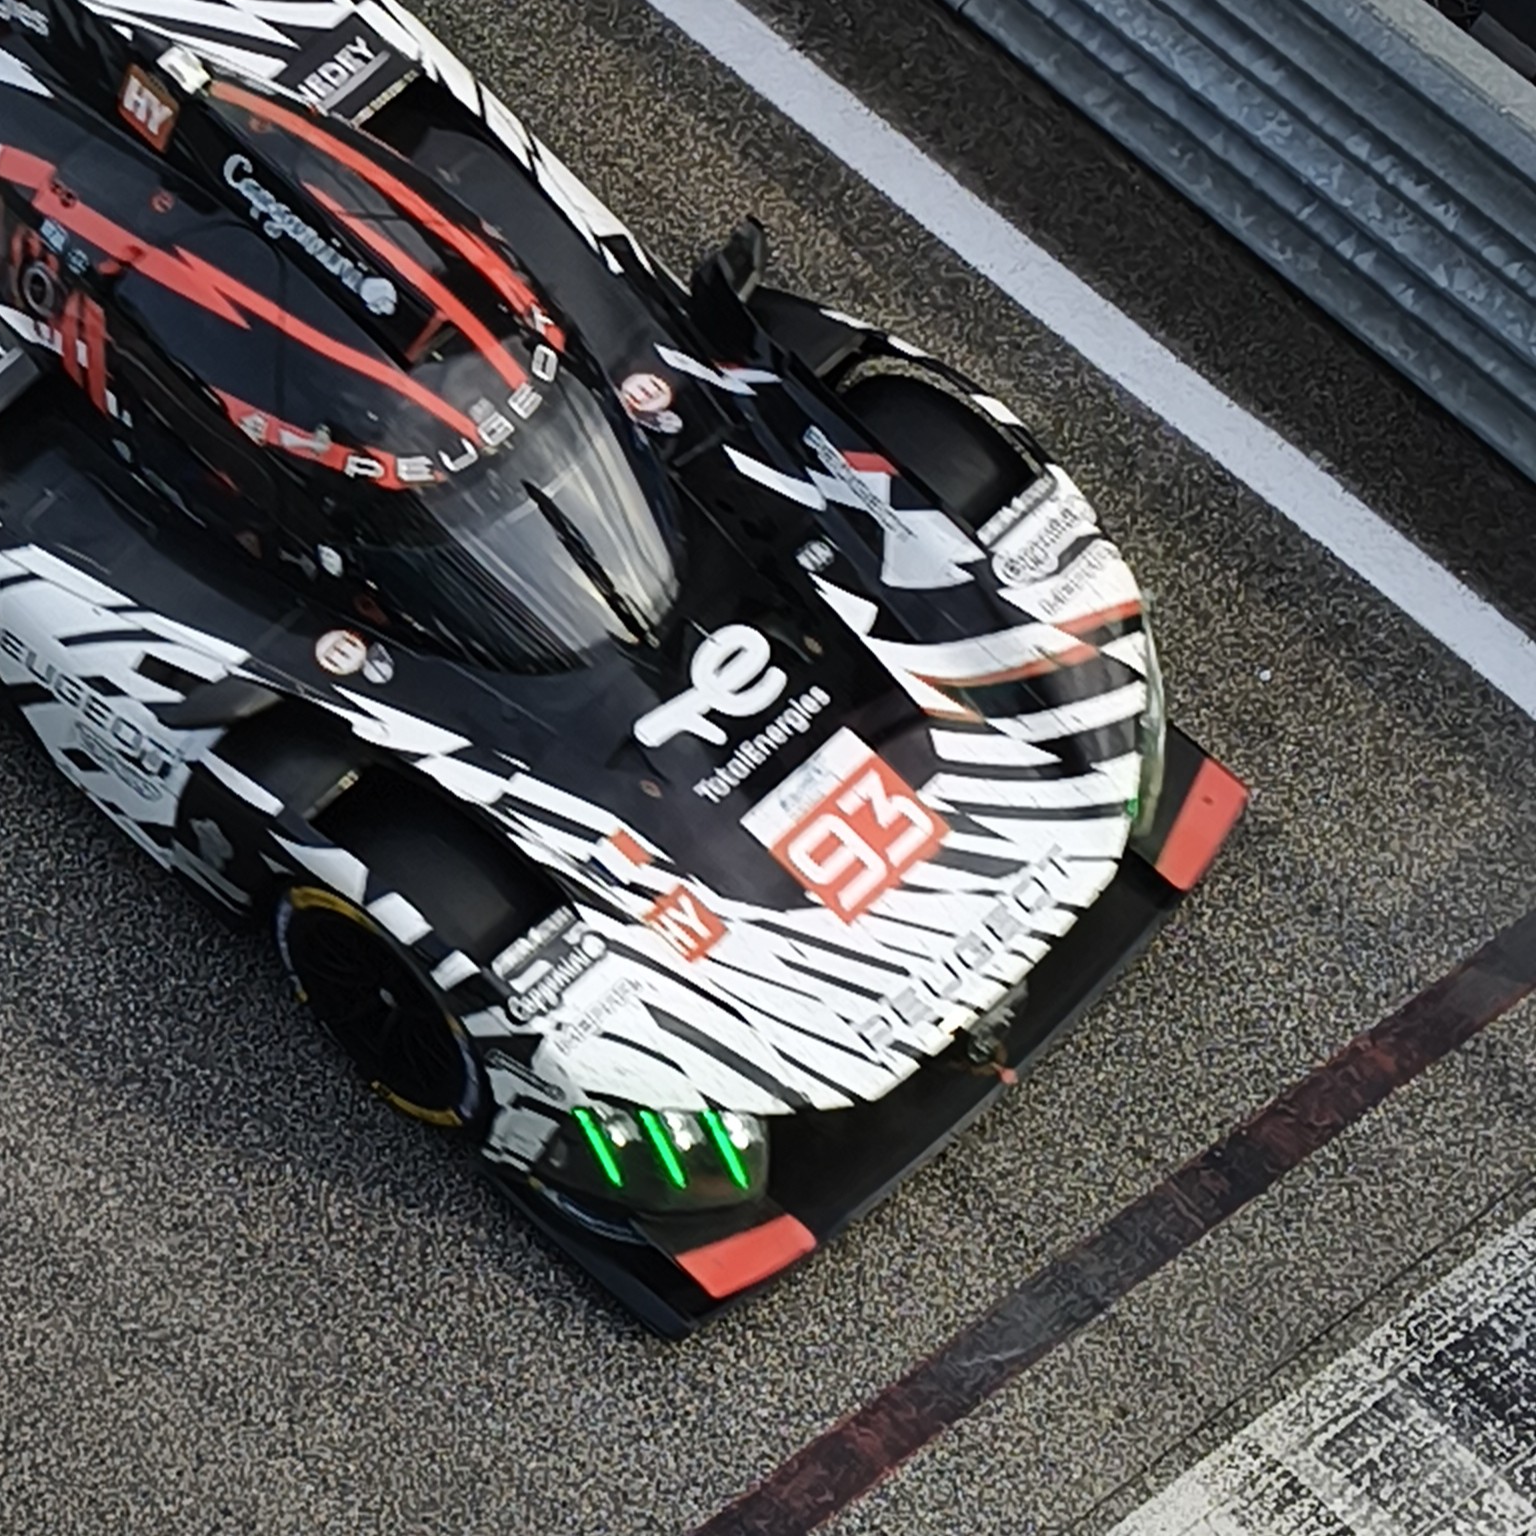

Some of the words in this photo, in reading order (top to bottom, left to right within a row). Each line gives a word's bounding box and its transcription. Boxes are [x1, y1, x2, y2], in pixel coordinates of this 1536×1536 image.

[123, 75, 174, 136] HY
[223, 154, 366, 294] Capgemini
[344, 303, 559, 482] PEUGEOT
[692, 686, 831, 803] TotalEnergies
[786, 769, 935, 912] 93
[855, 844, 1070, 1052] PEUGEOT
